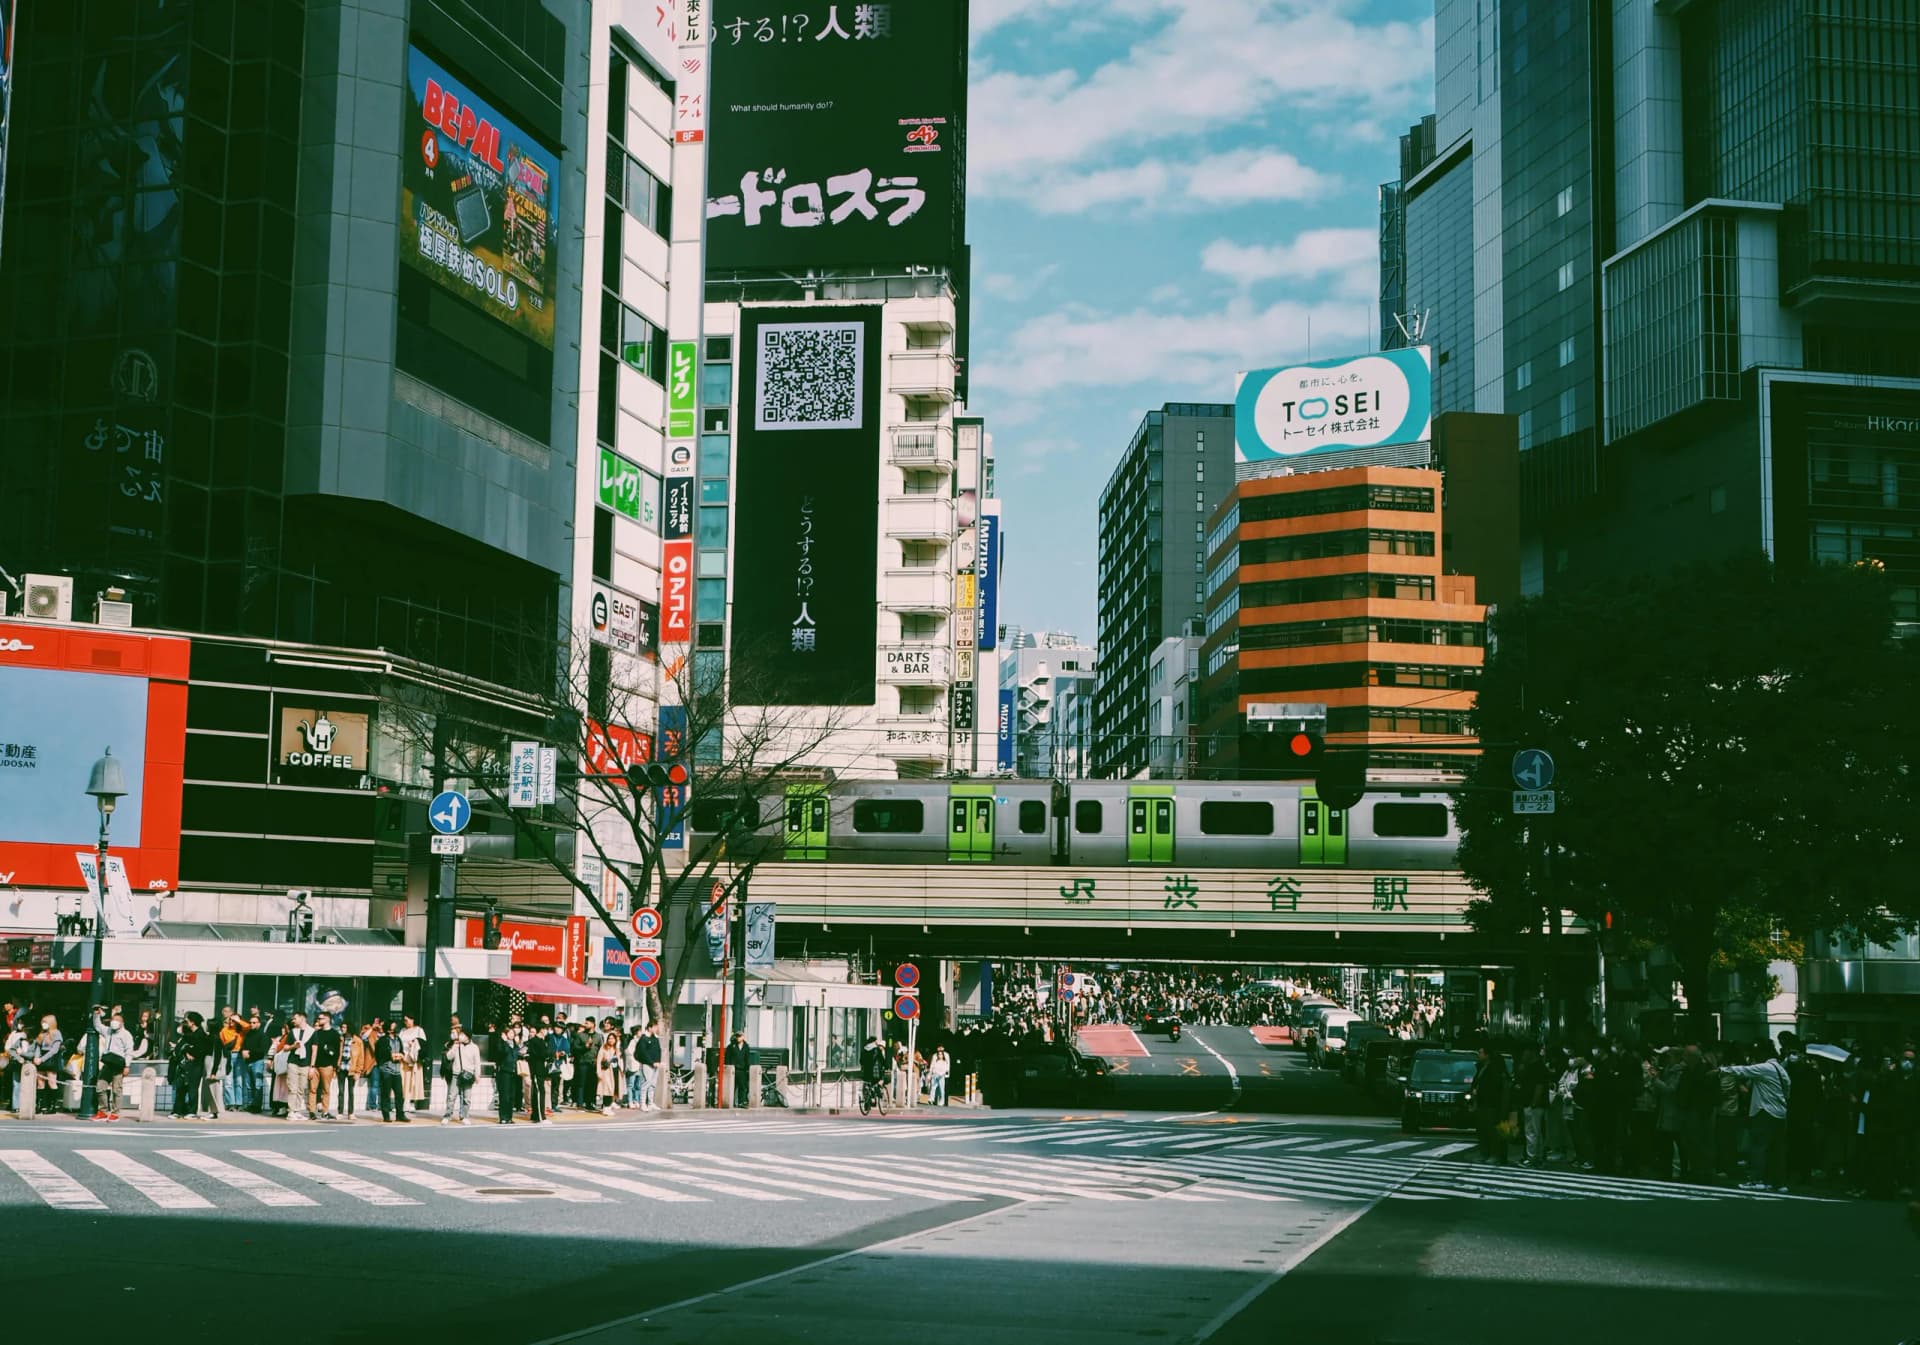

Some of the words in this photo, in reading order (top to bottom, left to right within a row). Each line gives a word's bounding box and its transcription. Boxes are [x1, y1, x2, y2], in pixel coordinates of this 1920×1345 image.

[730, 104, 751, 112] What
[752, 103, 778, 111] should
[779, 102, 814, 112] humanity
[816, 101, 833, 110] do!?
[423, 78, 504, 175] BE-PAL
[425, 138, 435, 163] 4
[673, 350, 691, 399] レイク
[1282, 390, 1380, 422] TOSEI
[1283, 416, 1380, 440] トーセイ株式会社
[601, 458, 638, 503] レイク
[612, 600, 636, 620] EAST
[669, 577, 687, 628] アコム
[887, 652, 930, 662] DARTS
[891, 665, 898, 673] &
[904, 664, 930, 673] BAR
[290, 752, 353, 769] COFFEE
[521, 747, 534, 801] 渋谷駅前
